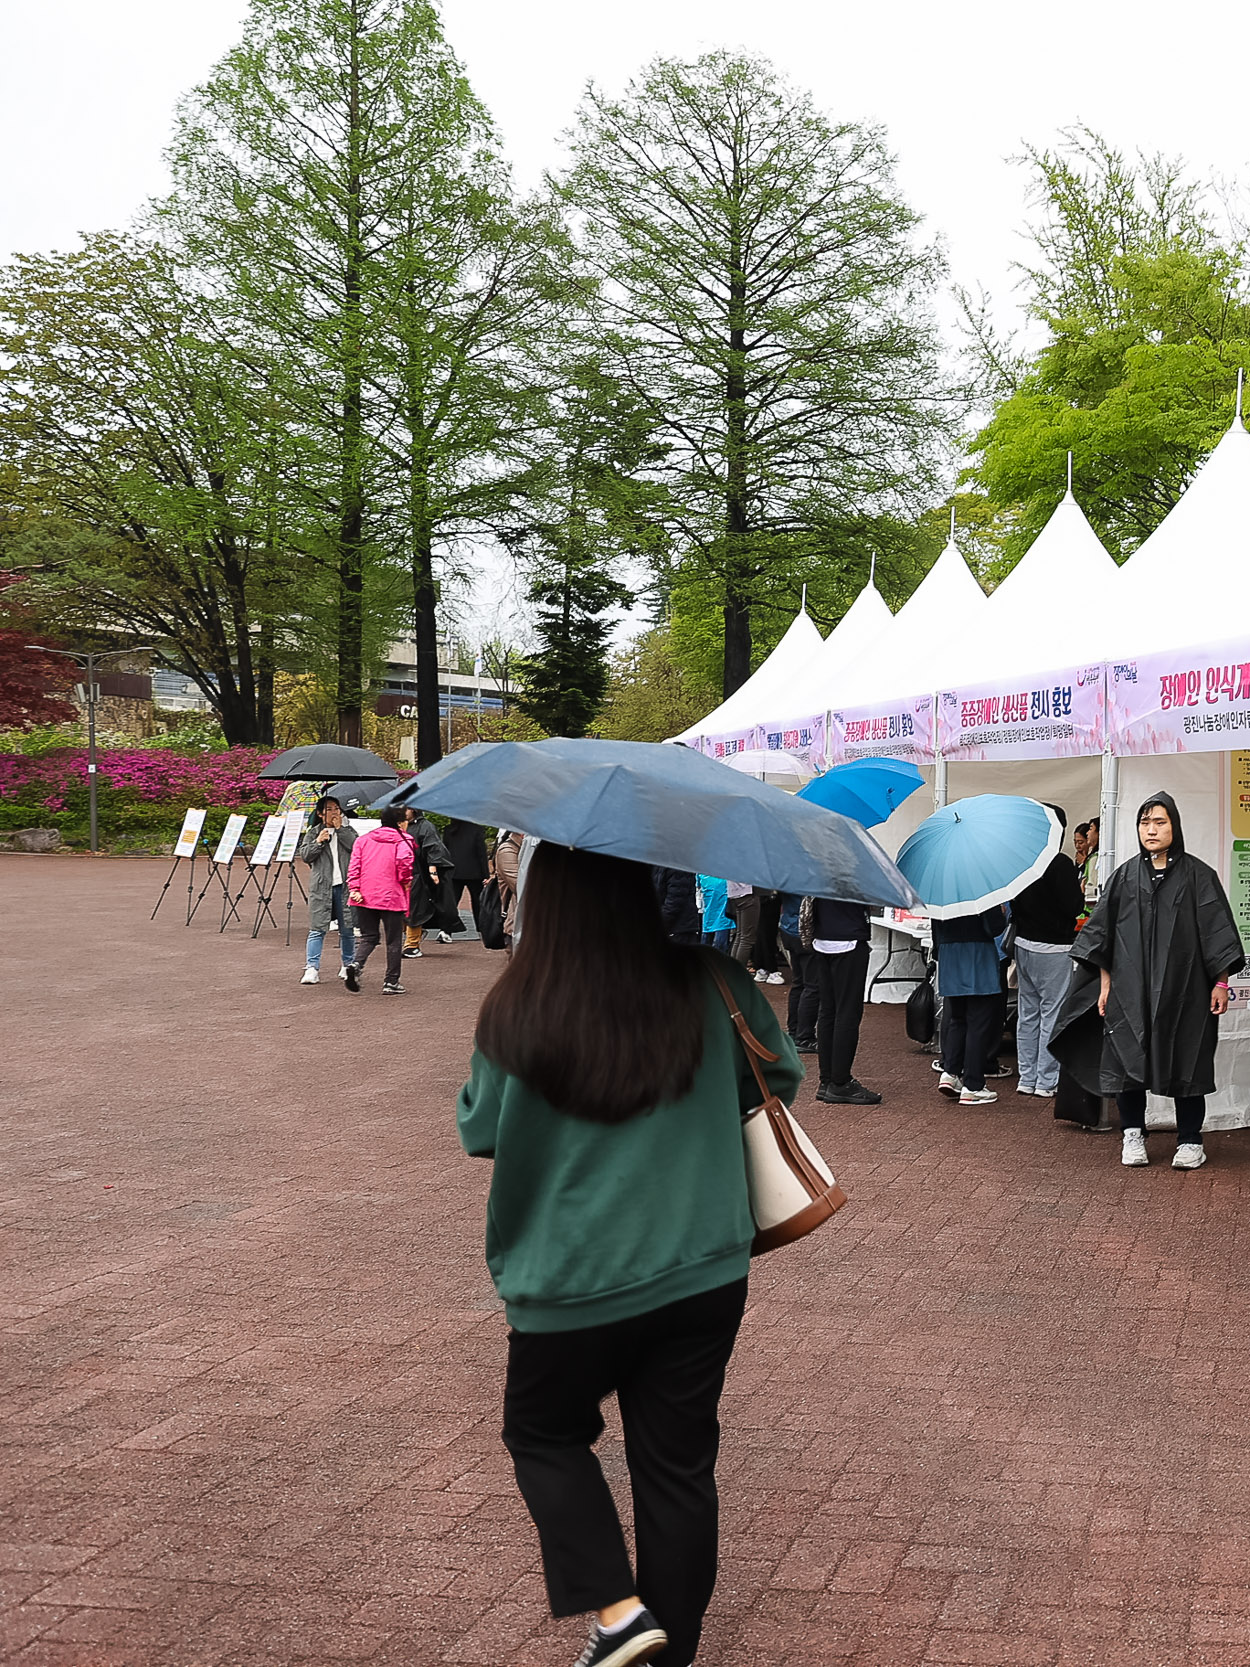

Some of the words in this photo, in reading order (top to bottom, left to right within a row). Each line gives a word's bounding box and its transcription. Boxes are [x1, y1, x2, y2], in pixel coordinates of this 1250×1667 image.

[1030, 688, 1050, 720] 전시
[1052, 686, 1072, 718] 홍보
[1160, 670, 1201, 710] 장애인
